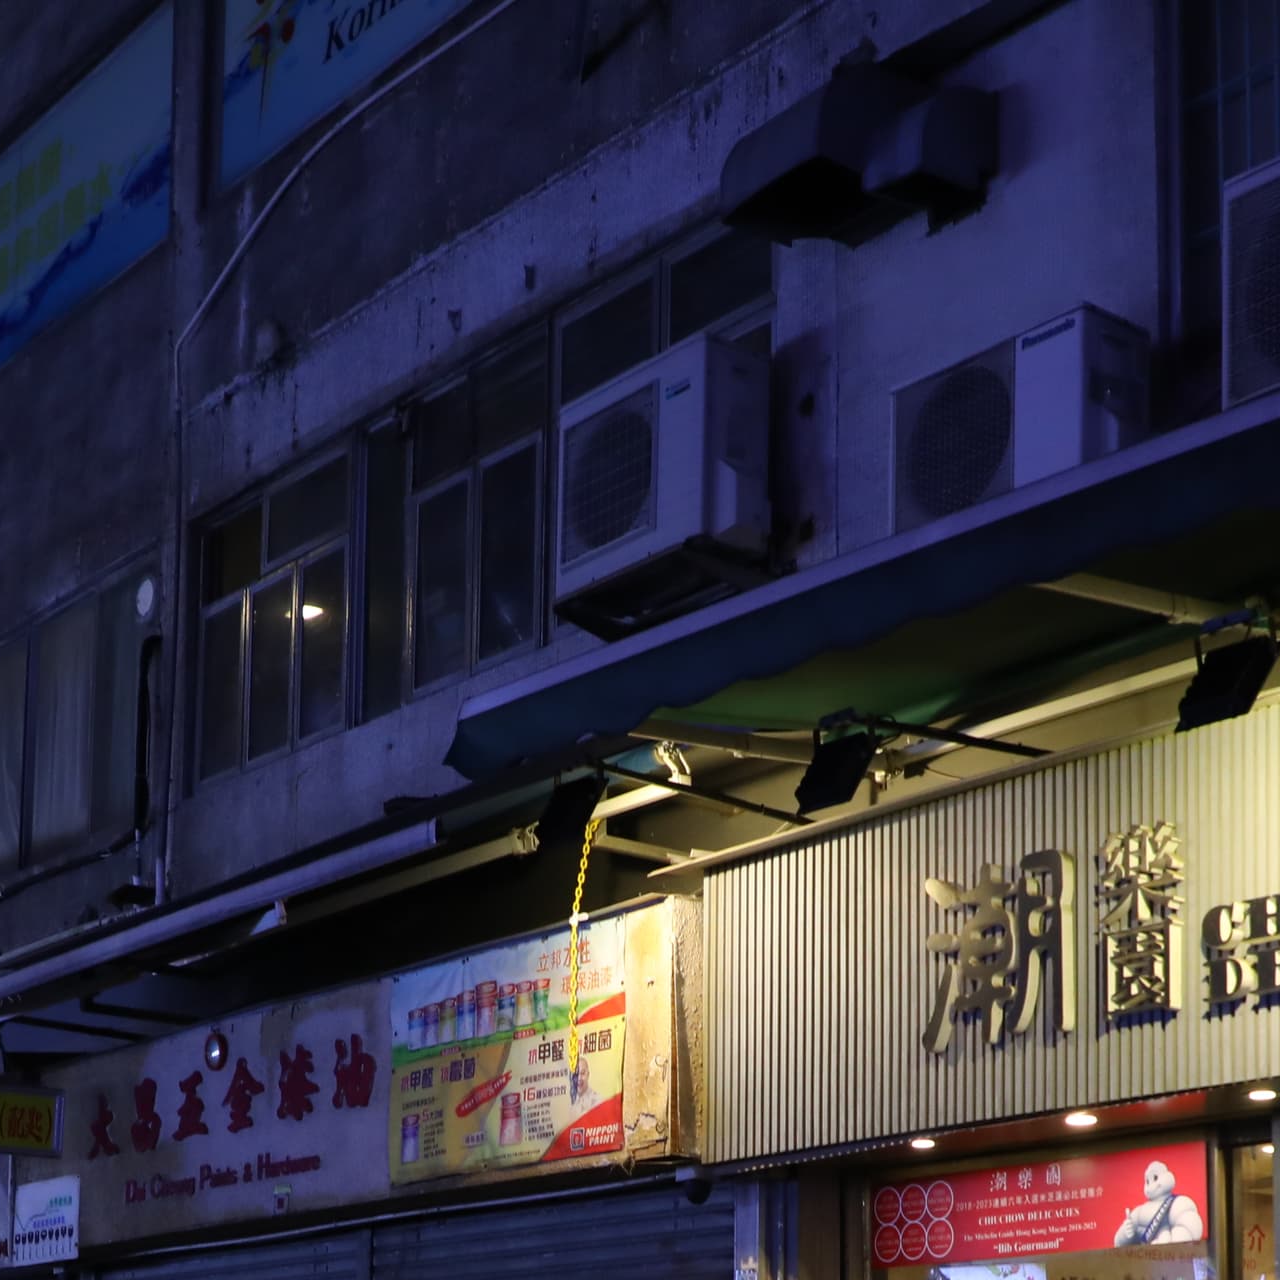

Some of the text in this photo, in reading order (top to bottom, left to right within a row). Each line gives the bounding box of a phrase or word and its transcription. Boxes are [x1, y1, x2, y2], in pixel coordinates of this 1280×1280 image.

[922, 820, 1184, 1053] 潮 樂園
[577, 1028, 613, 1055] 細菌
[585, 1123, 619, 1138] NIPPON
[589, 1134, 616, 1147] PAINT
[978, 1206, 1081, 1226] CHIUCHOW DELICACIES
